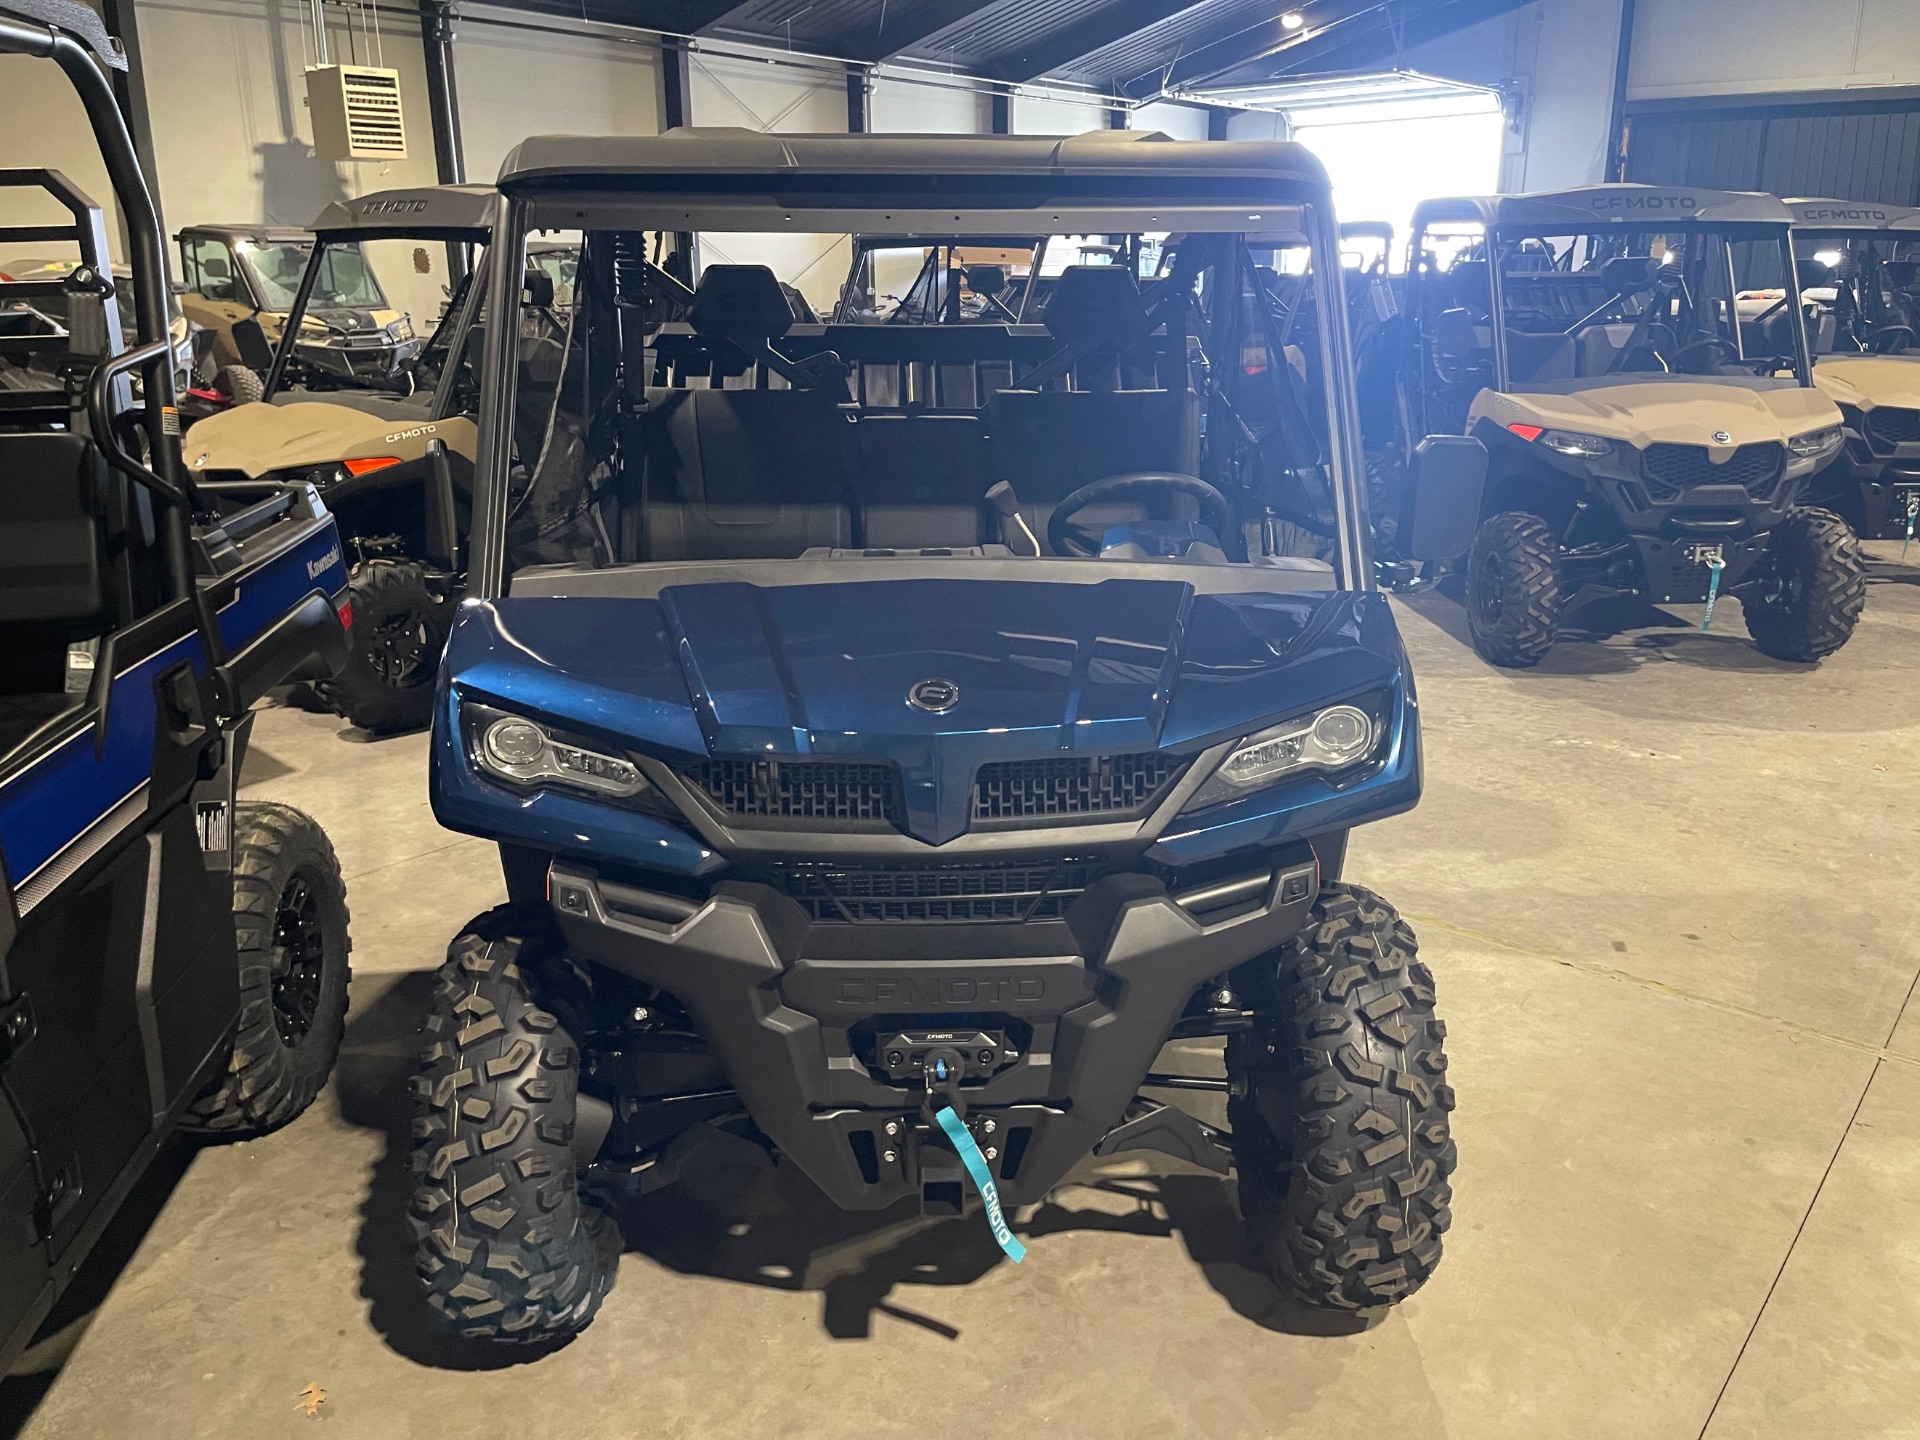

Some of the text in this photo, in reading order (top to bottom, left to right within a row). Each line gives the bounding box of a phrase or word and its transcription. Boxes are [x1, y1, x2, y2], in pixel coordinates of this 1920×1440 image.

[361, 200, 428, 214] CFMOTO
[1591, 196, 1697, 209] CFMOTO
[1803, 210, 1885, 220] CFMOTO
[385, 425, 437, 443] CFMOTO
[306, 543, 340, 580] Kawasaki
[836, 975, 1046, 1004] CFMOTO
[982, 1181, 1011, 1246] CFMOTO
